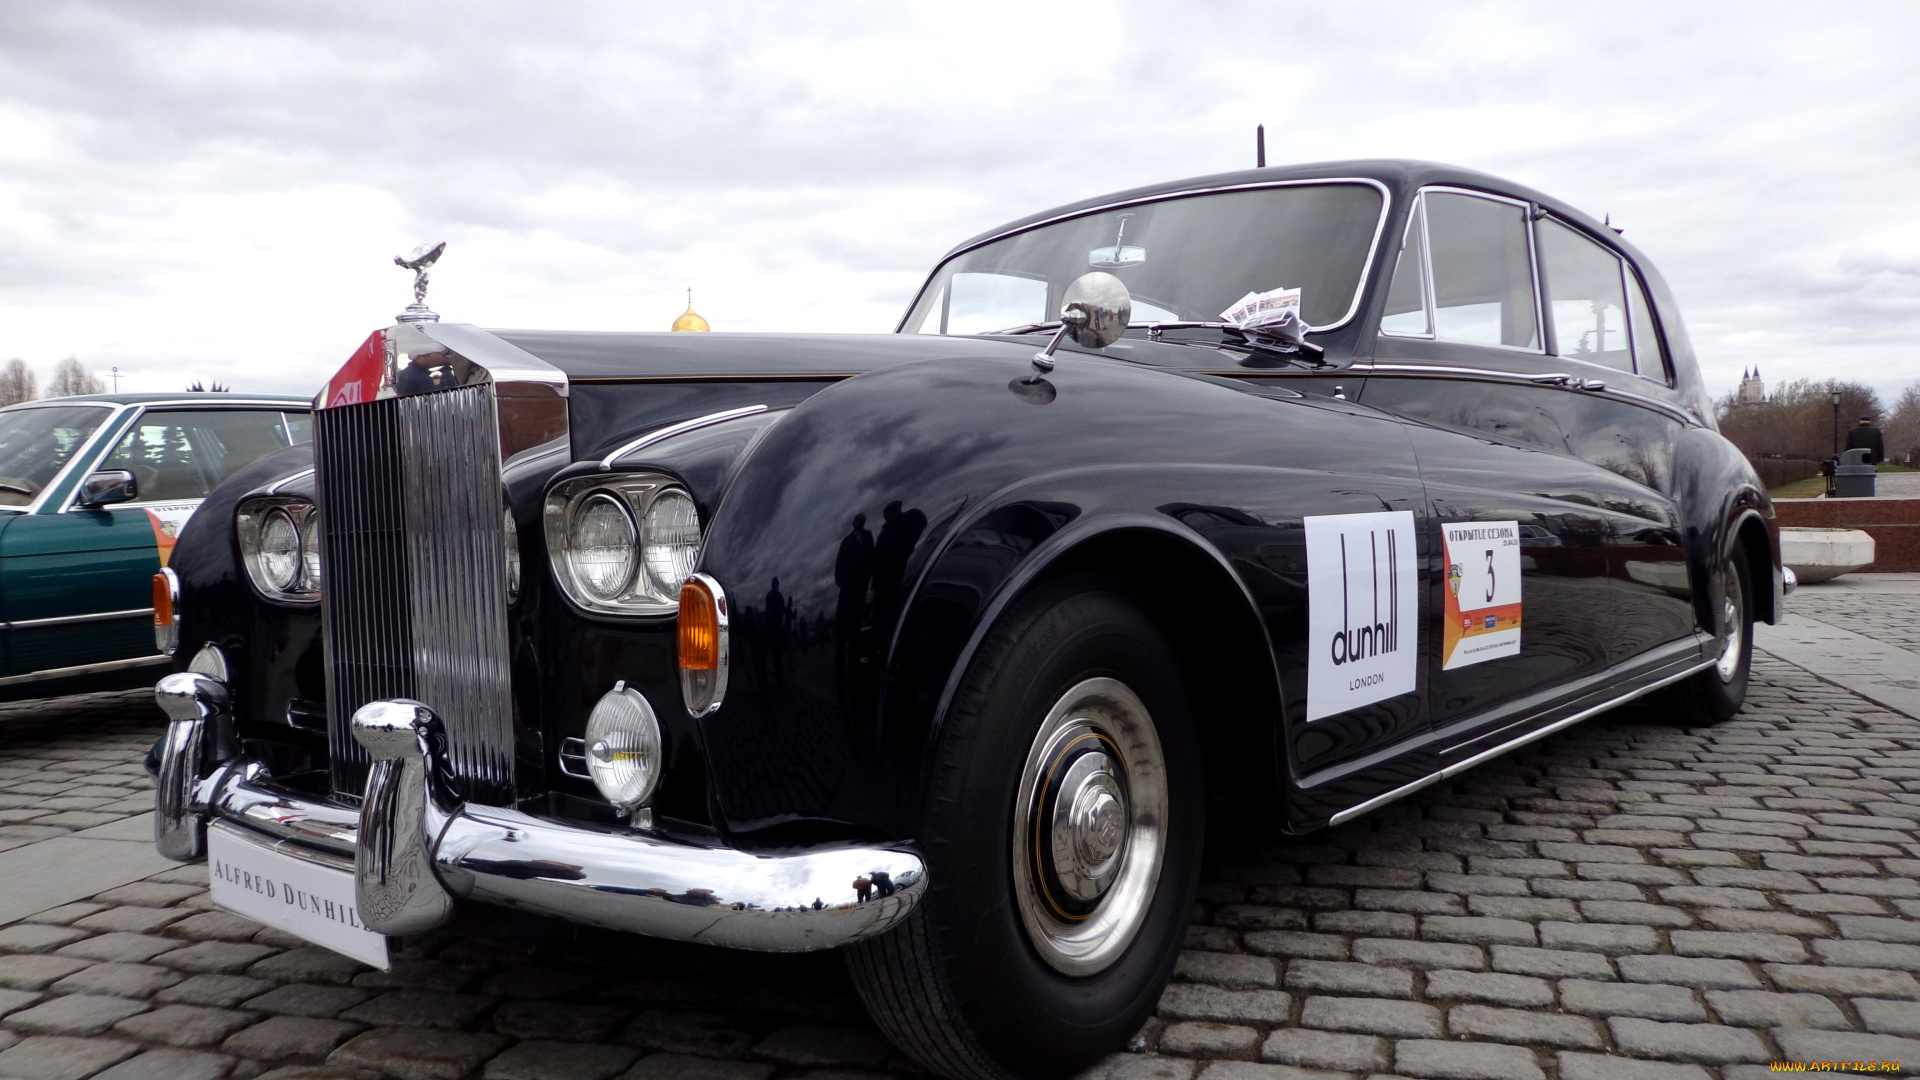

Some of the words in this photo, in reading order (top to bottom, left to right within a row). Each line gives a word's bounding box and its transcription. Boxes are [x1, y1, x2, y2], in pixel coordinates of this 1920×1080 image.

[1487, 527, 1514, 540] СЕЗОНА
[1485, 549, 1496, 603] 3
[1331, 529, 1398, 666] dunhill
[1349, 672, 1385, 691] LONDON
[214, 857, 275, 898] ALFRED
